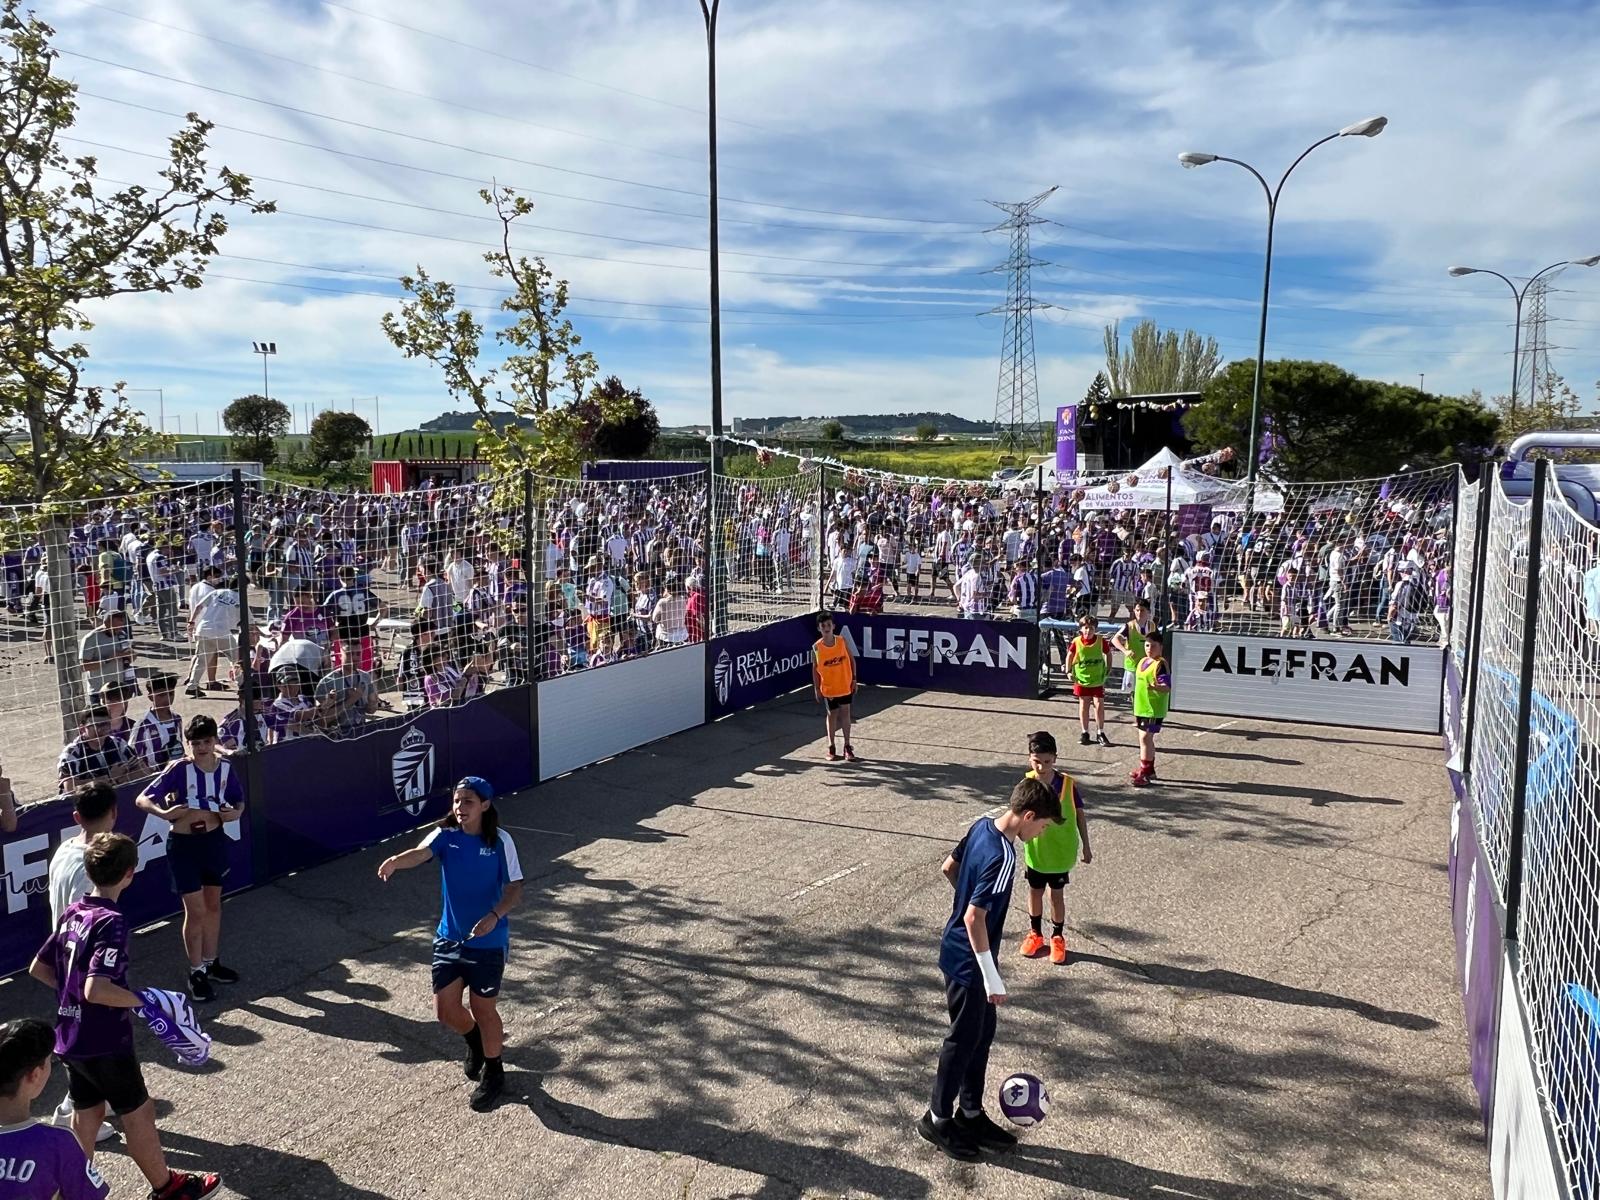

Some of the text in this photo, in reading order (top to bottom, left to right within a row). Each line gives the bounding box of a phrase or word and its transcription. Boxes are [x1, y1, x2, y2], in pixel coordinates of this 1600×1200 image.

[1085, 493, 1134, 501] ALIMENTOS
[736, 648, 772, 673] REAL
[1202, 644, 1410, 687] ALEFRAN
